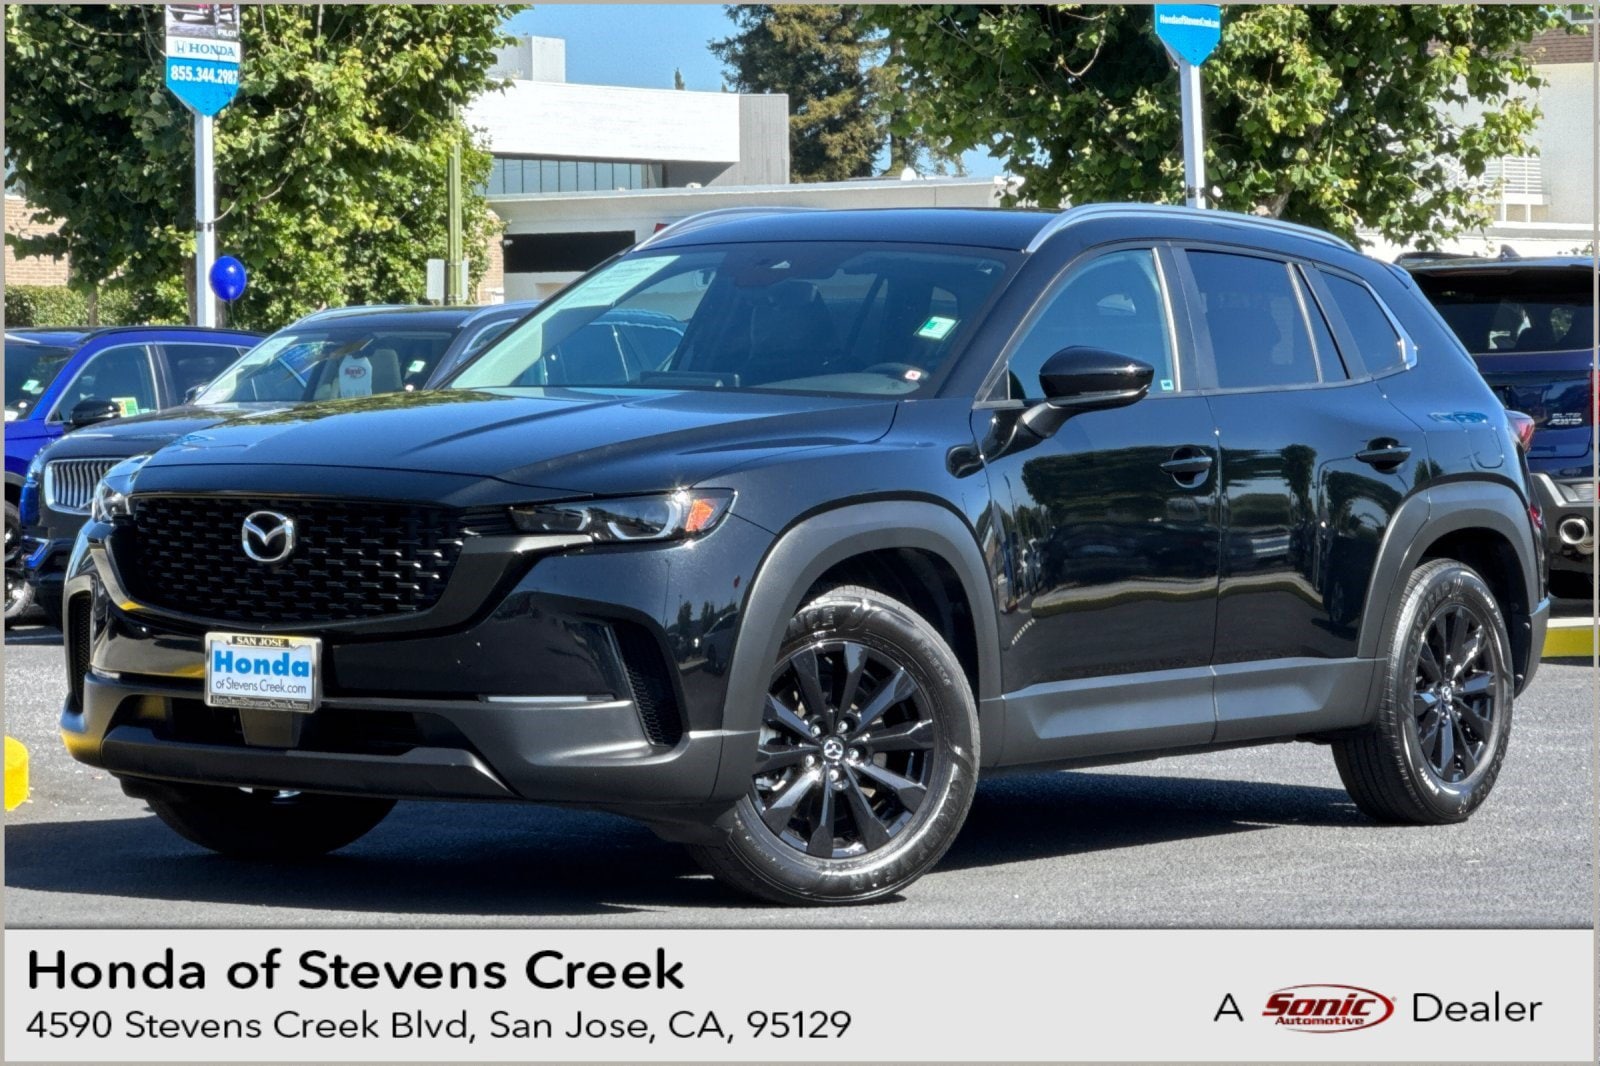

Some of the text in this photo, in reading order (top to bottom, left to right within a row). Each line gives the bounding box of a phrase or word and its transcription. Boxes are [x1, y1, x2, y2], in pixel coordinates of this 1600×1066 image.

[188, 42, 236, 57] HONDA
[236, 636, 286, 648] SAN JOSE
[214, 650, 310, 678] Honda
[215, 677, 307, 694] of Stevens Creek.com
